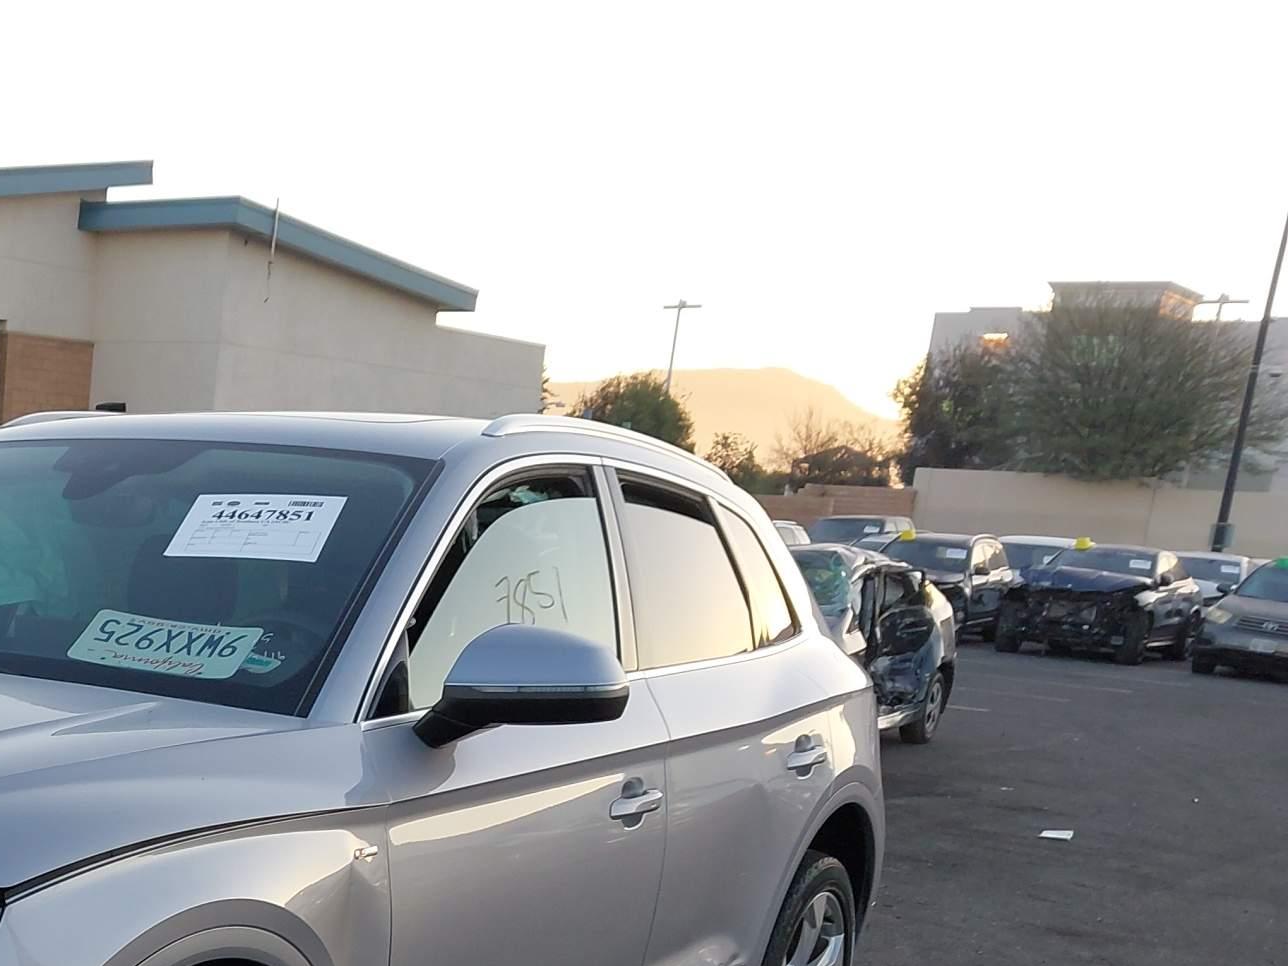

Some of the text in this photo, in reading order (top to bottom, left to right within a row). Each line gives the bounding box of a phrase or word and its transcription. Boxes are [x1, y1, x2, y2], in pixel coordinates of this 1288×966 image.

[212, 509, 314, 521] 44647851
[495, 567, 568, 624] 7851
[93, 619, 249, 658] 9WXX925
[104, 649, 205, 676] California
